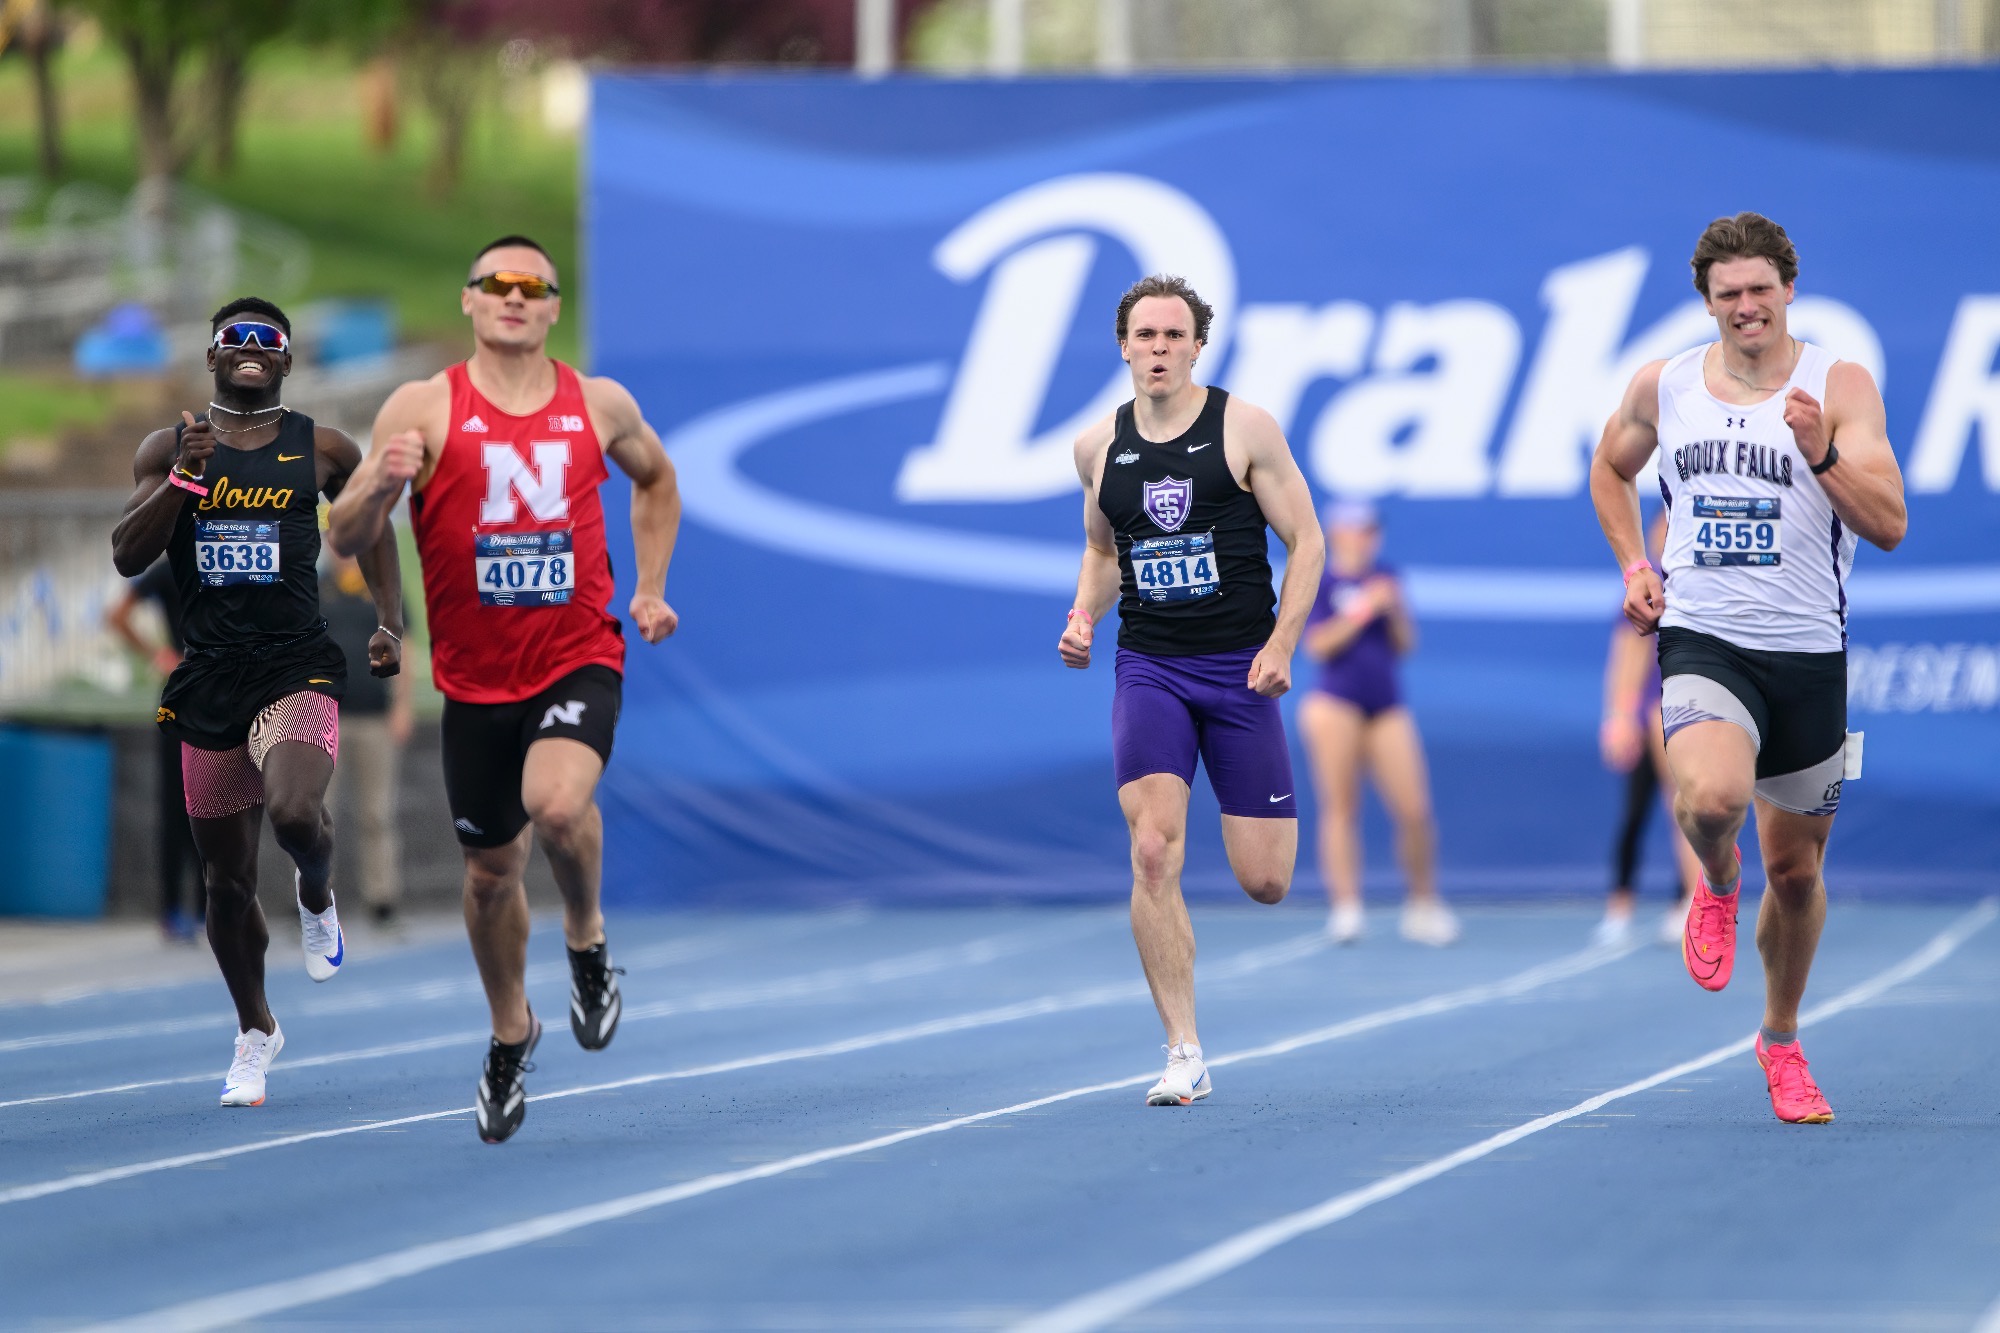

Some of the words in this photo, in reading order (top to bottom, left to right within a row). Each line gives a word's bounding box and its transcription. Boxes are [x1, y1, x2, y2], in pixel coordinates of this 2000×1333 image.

[1735, 441, 1793, 488] FALLS
[199, 476, 294, 510] Iowa
[479, 439, 572, 525] N
[1697, 522, 1774, 550] 4559
[200, 544, 273, 571] 3638
[1141, 556, 1213, 587] 4814
[484, 558, 567, 589] 4078
